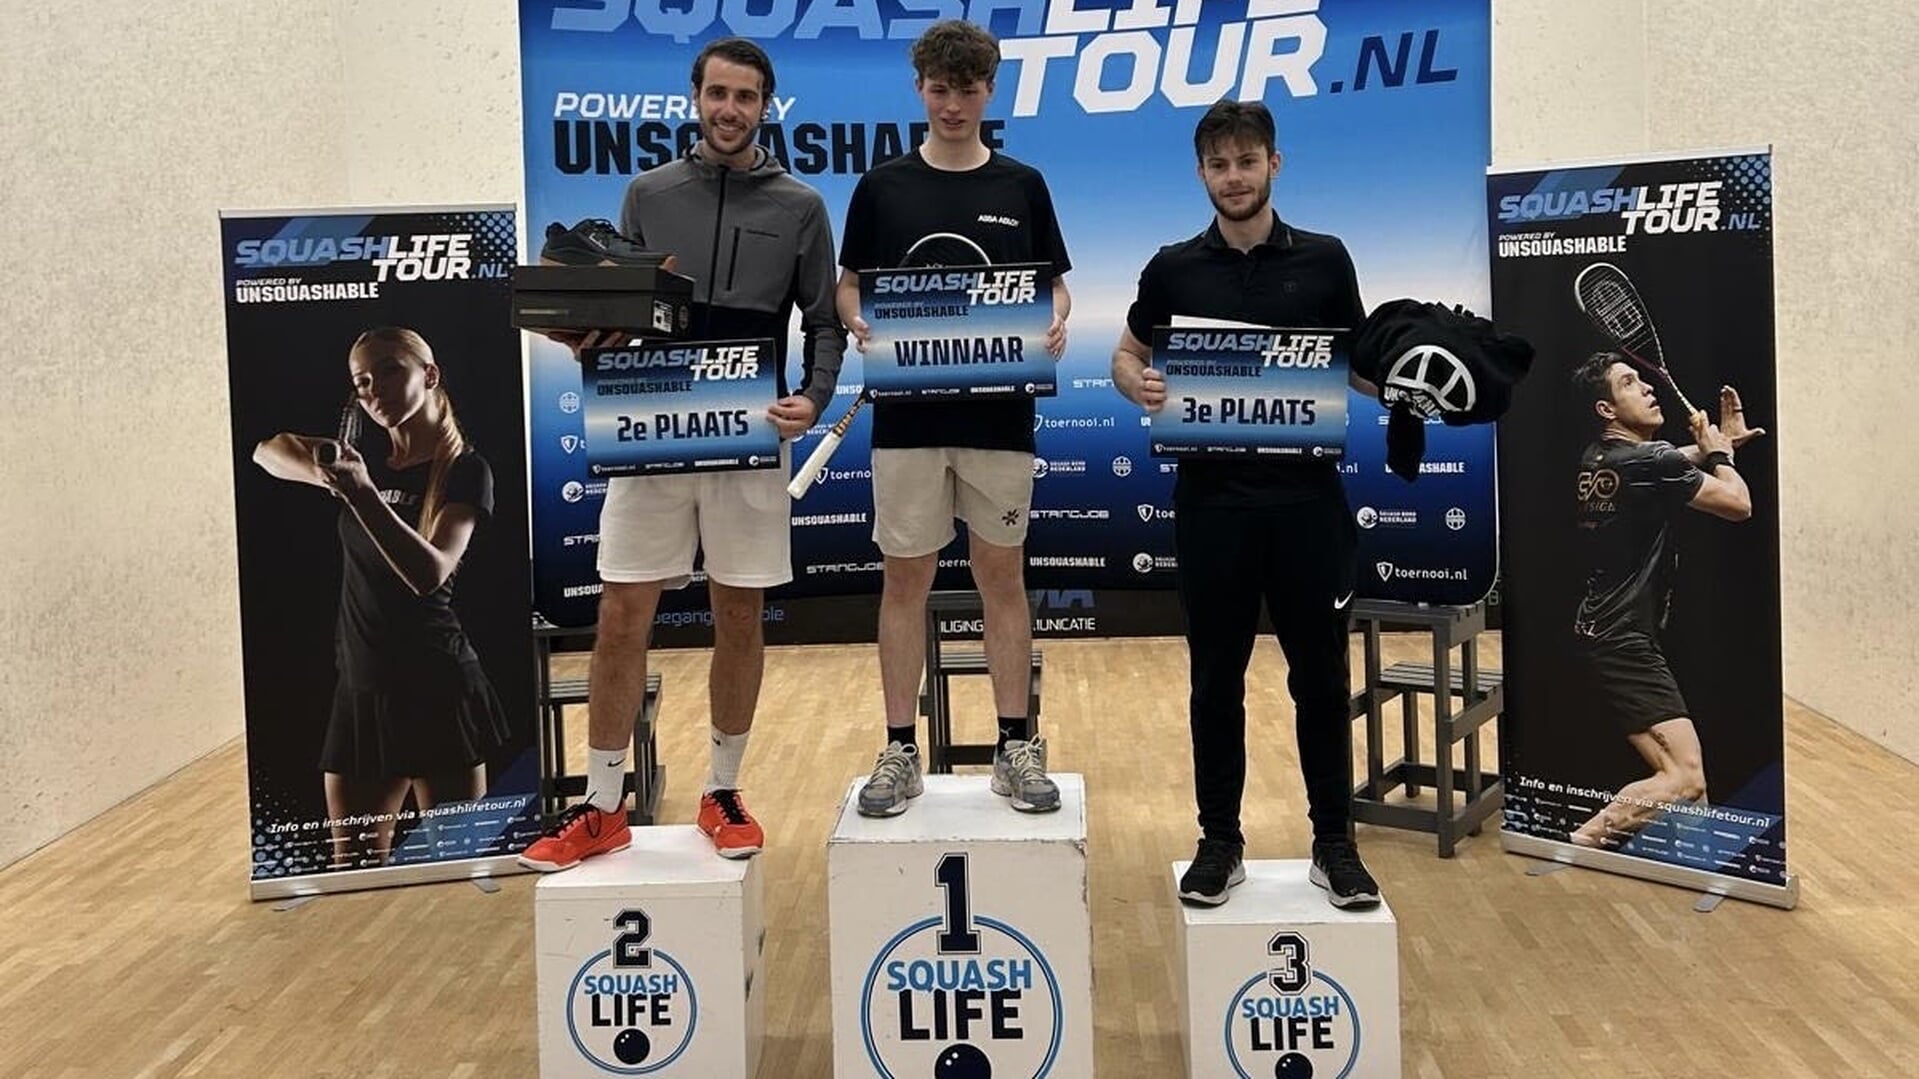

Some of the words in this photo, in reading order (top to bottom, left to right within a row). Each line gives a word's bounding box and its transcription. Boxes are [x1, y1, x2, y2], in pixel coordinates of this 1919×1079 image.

[551, 0, 1320, 44] QUASH
[554, 93, 700, 119] POWER
[554, 119, 1005, 175] UNSASHA
[1499, 235, 1627, 258] UNSQUASHABLE
[1543, 231, 1556, 239] BY
[236, 282, 379, 303] UNSQUASHABLE
[288, 278, 302, 286] BY
[966, 287, 1037, 307] TOUR
[874, 305, 969, 320] UNSQUASHABLE
[894, 336, 1024, 368] WINNAAR
[1260, 350, 1333, 369] TOUR
[690, 363, 760, 382] TOUR
[1166, 364, 1262, 377] UNSQUASHABLE
[596, 380, 693, 396] UNSQUASHABLE
[1045, 416, 1115, 428] toernooi.nl
[1182, 397, 1213, 424] 3e
[1221, 397, 1316, 426] PLAATS
[617, 415, 648, 442] 2e
[655, 409, 750, 440] PLAATS
[830, 468, 872, 481] toerno
[791, 513, 867, 526] UNSQUASHABLE
[1030, 556, 1107, 568] UNSQUASHABLE
[1395, 568, 1468, 581] toernooi.nl
[563, 584, 604, 598] UNSQUA
[1519, 776, 1546, 790] Info
[1548, 782, 1564, 793] en
[1566, 784, 1633, 805] inschrijven
[1635, 796, 1655, 808] via
[1657, 801, 1770, 828] squashlifetour.nl
[270, 822, 299, 834] Info
[302, 821, 320, 831] en
[323, 812, 393, 829] inschrijven
[396, 809, 416, 821] via
[418, 797, 527, 820] squashlifetour.nl
[934, 851, 982, 955] 1
[612, 907, 652, 968] 2
[1267, 931, 1312, 996] 3
[584, 974, 678, 995] SQUASH
[887, 959, 1032, 992] SQUASH
[591, 993, 672, 1027] LIFE
[899, 988, 1024, 1041] LIFE
[1242, 995, 1340, 1019] SQUASH
[1250, 1015, 1335, 1052] LIFE
